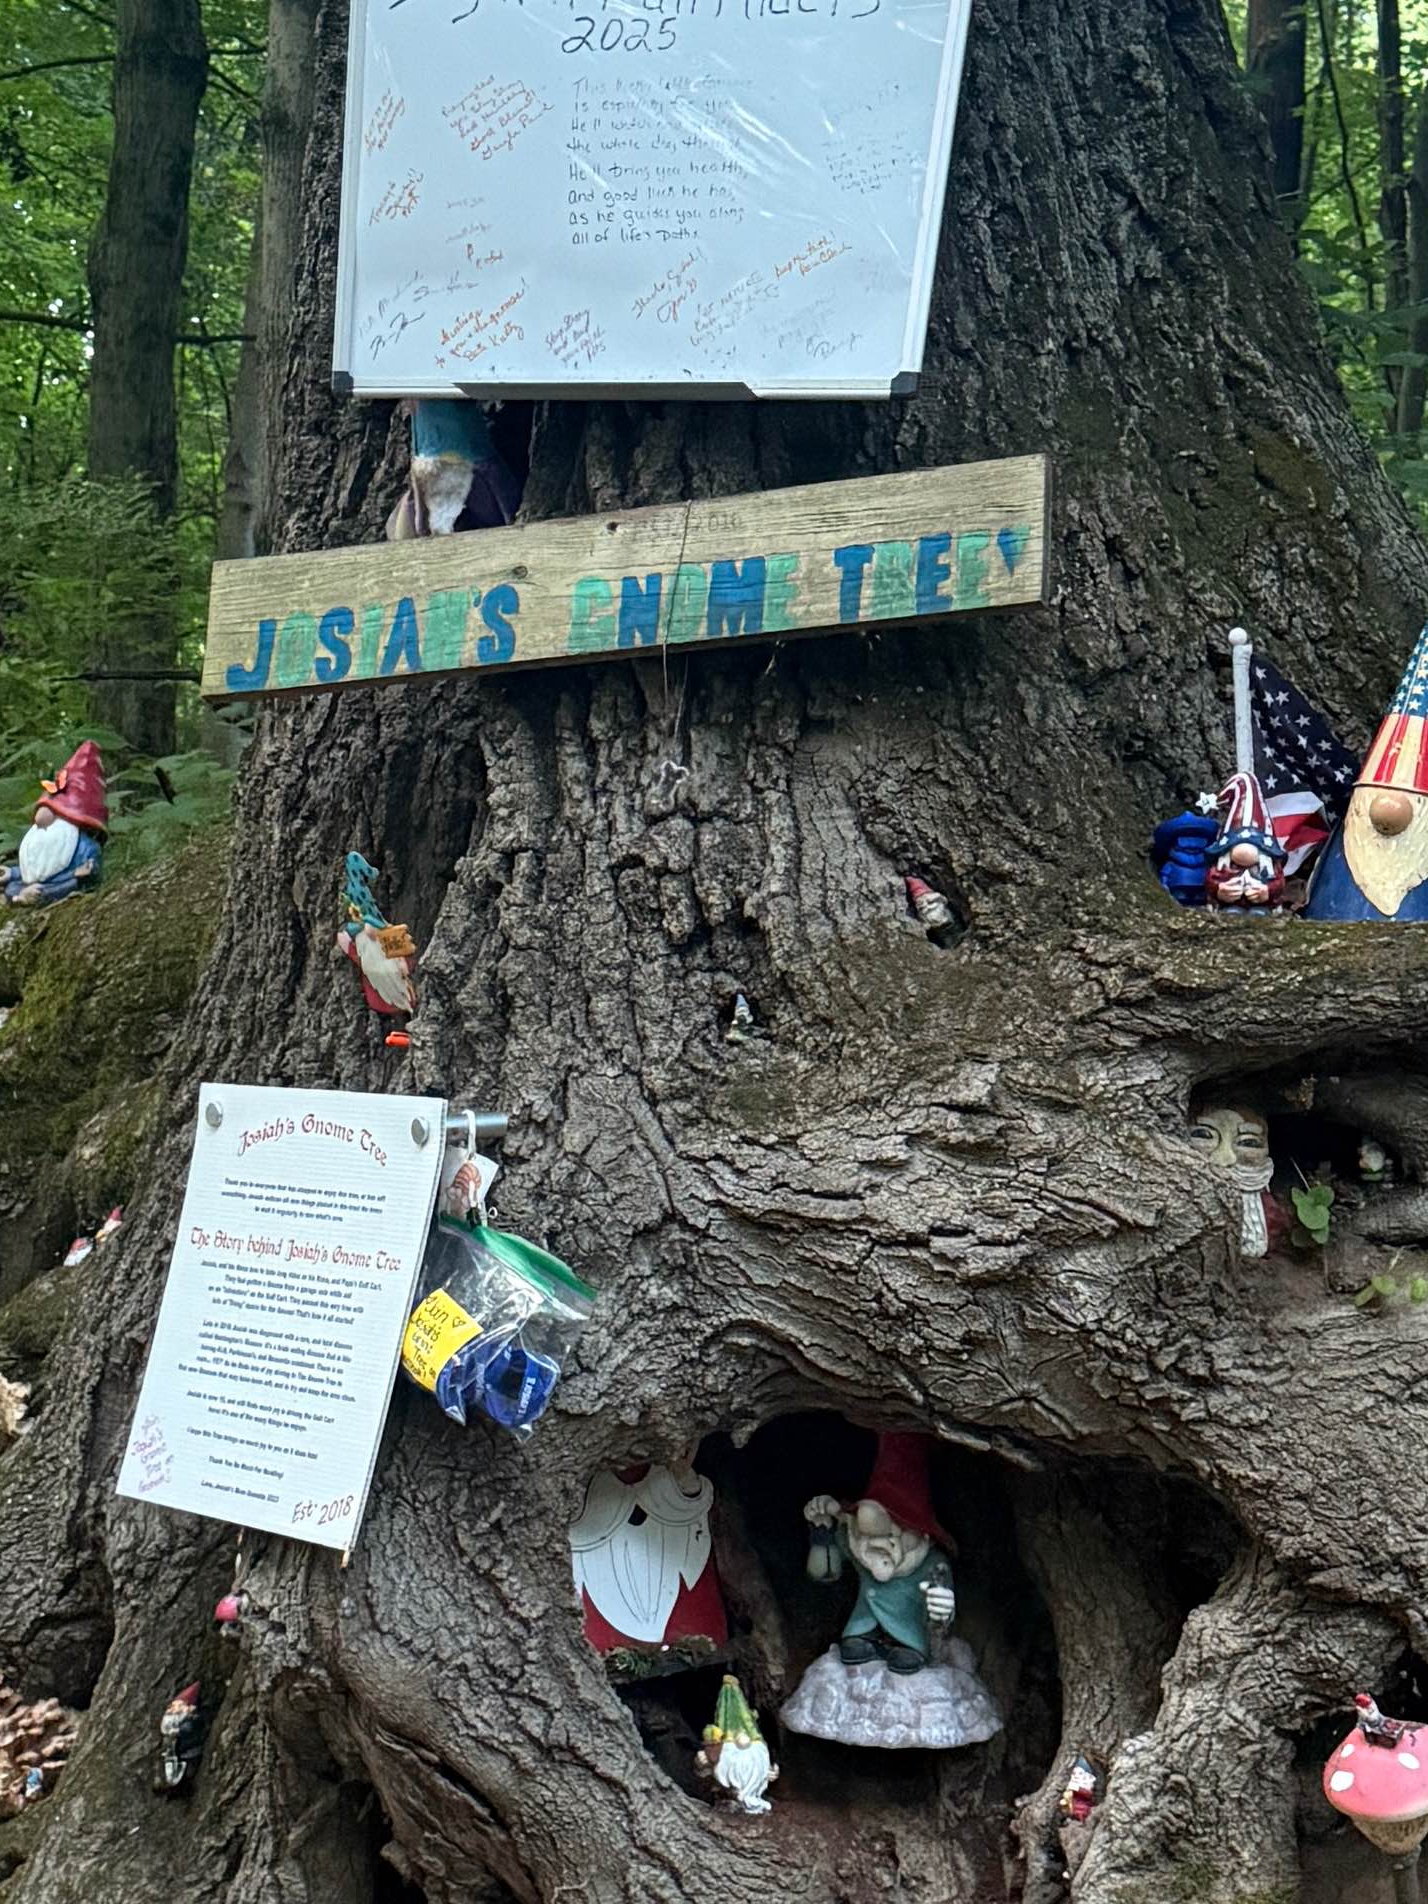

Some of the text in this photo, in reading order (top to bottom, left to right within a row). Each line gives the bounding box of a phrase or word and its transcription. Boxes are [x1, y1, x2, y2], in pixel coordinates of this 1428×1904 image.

[562, 18, 677, 53] 2025
[603, 187, 638, 207] good
[594, 228, 609, 243] of
[225, 530, 992, 692] JOSIAH'S GNOME TREE
[237, 1113, 388, 1167] Josiah's Gnome Tree
[190, 1226, 401, 1272] The Story behind Josiah's Gnome Tree
[317, 1495, 354, 1525] 2018
